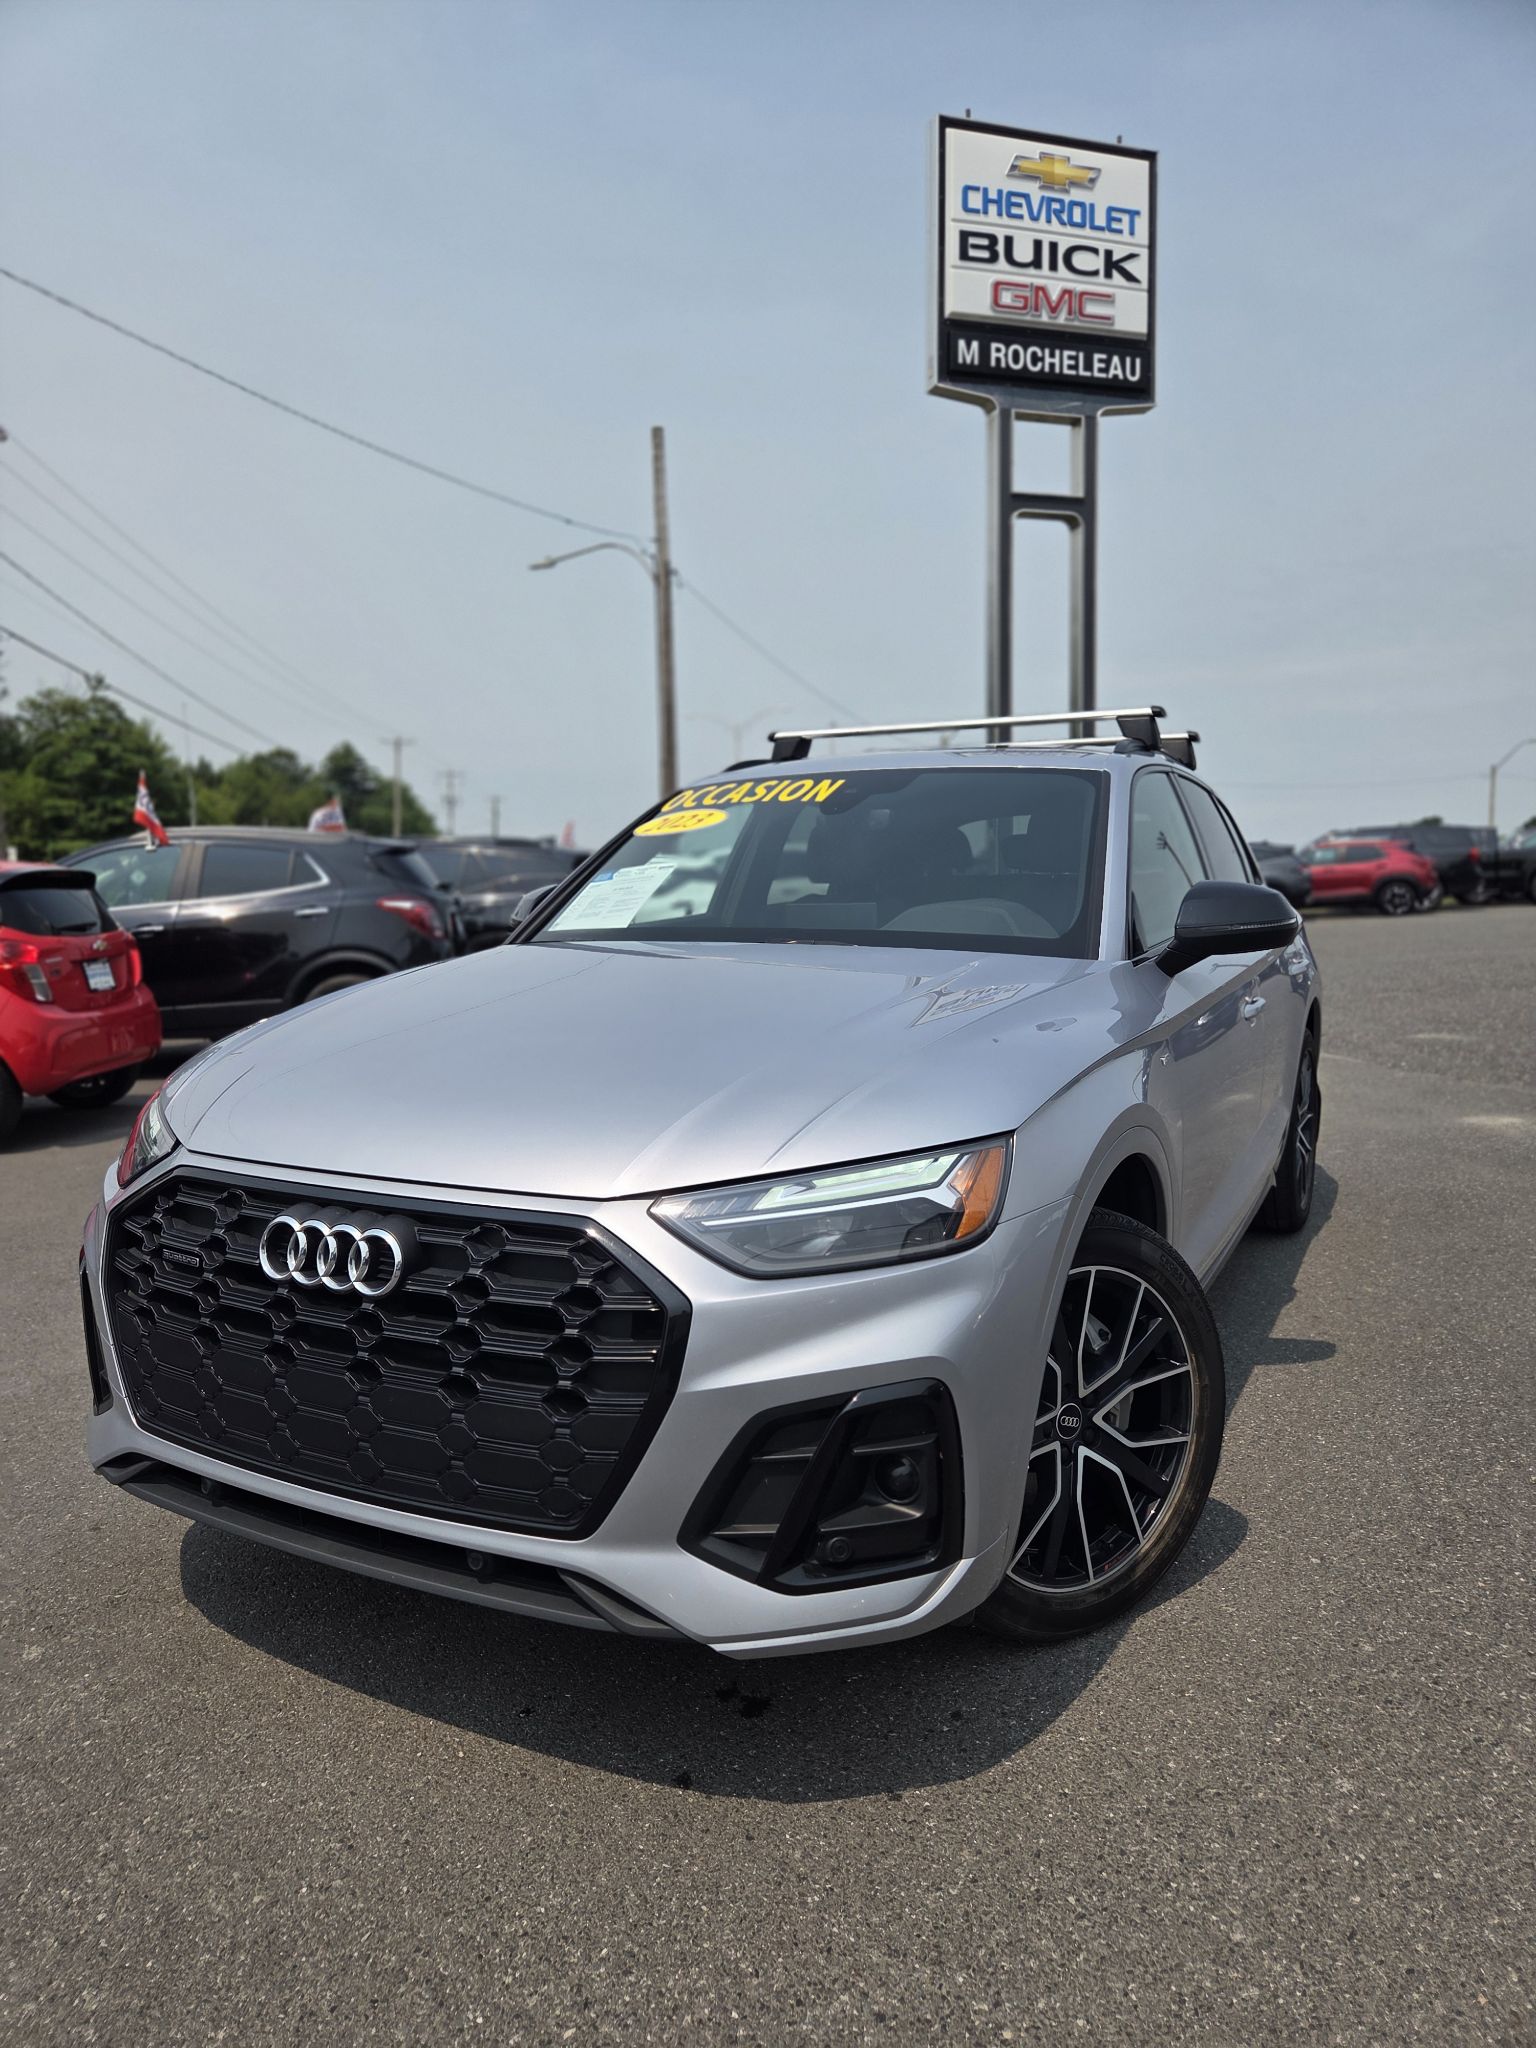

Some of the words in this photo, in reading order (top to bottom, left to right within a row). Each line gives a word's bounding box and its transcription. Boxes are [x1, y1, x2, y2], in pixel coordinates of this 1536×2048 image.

[961, 184, 1141, 236] CHEVROLET
[959, 229, 1141, 284] BUICK
[991, 279, 1115, 325] GMC
[957, 338, 979, 366] M
[990, 342, 1141, 382] ROCHELEAU
[661, 779, 845, 812] OCCASION
